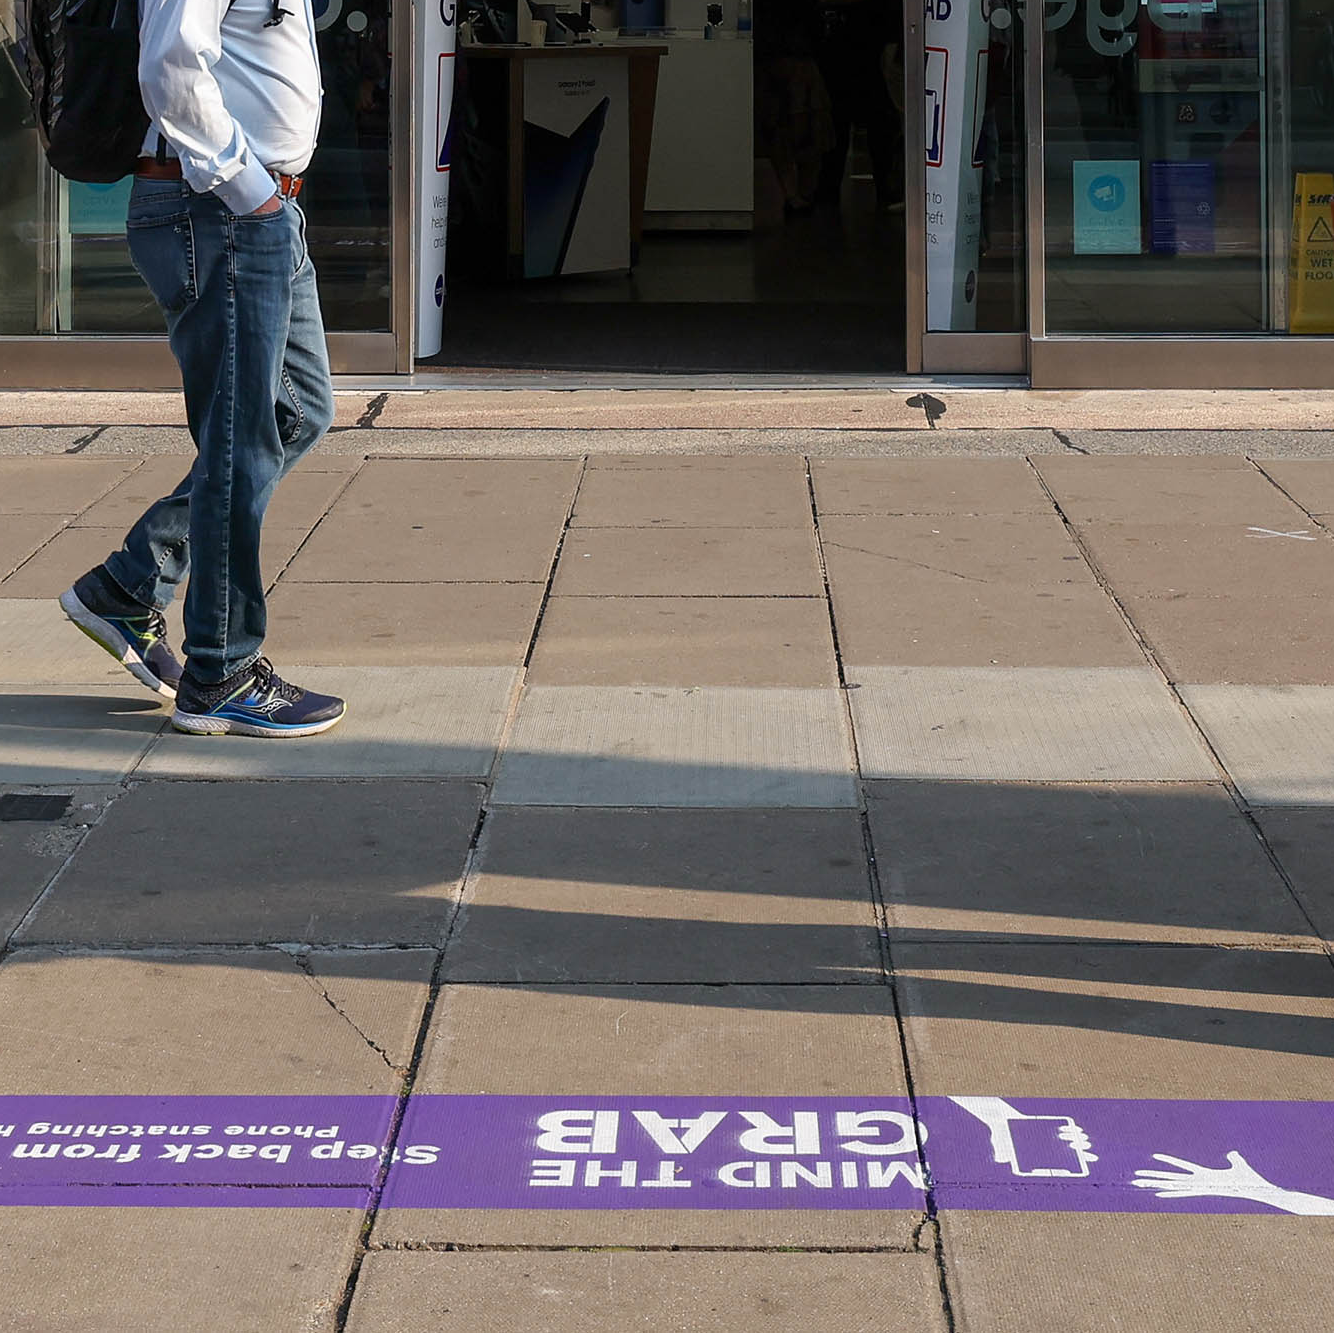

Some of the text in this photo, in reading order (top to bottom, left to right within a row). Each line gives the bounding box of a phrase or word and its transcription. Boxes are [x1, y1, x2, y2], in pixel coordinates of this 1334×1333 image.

[1310, 257, 1333, 268] WET
[27, 1122, 217, 1139] snatching
[223, 1124, 340, 1139] Phone
[532, 1109, 930, 1156] GRAB
[11, 1141, 144, 1164] from
[158, 1142, 291, 1164] back
[310, 1140, 442, 1166] Step
[528, 1159, 933, 1191] MIND THE
